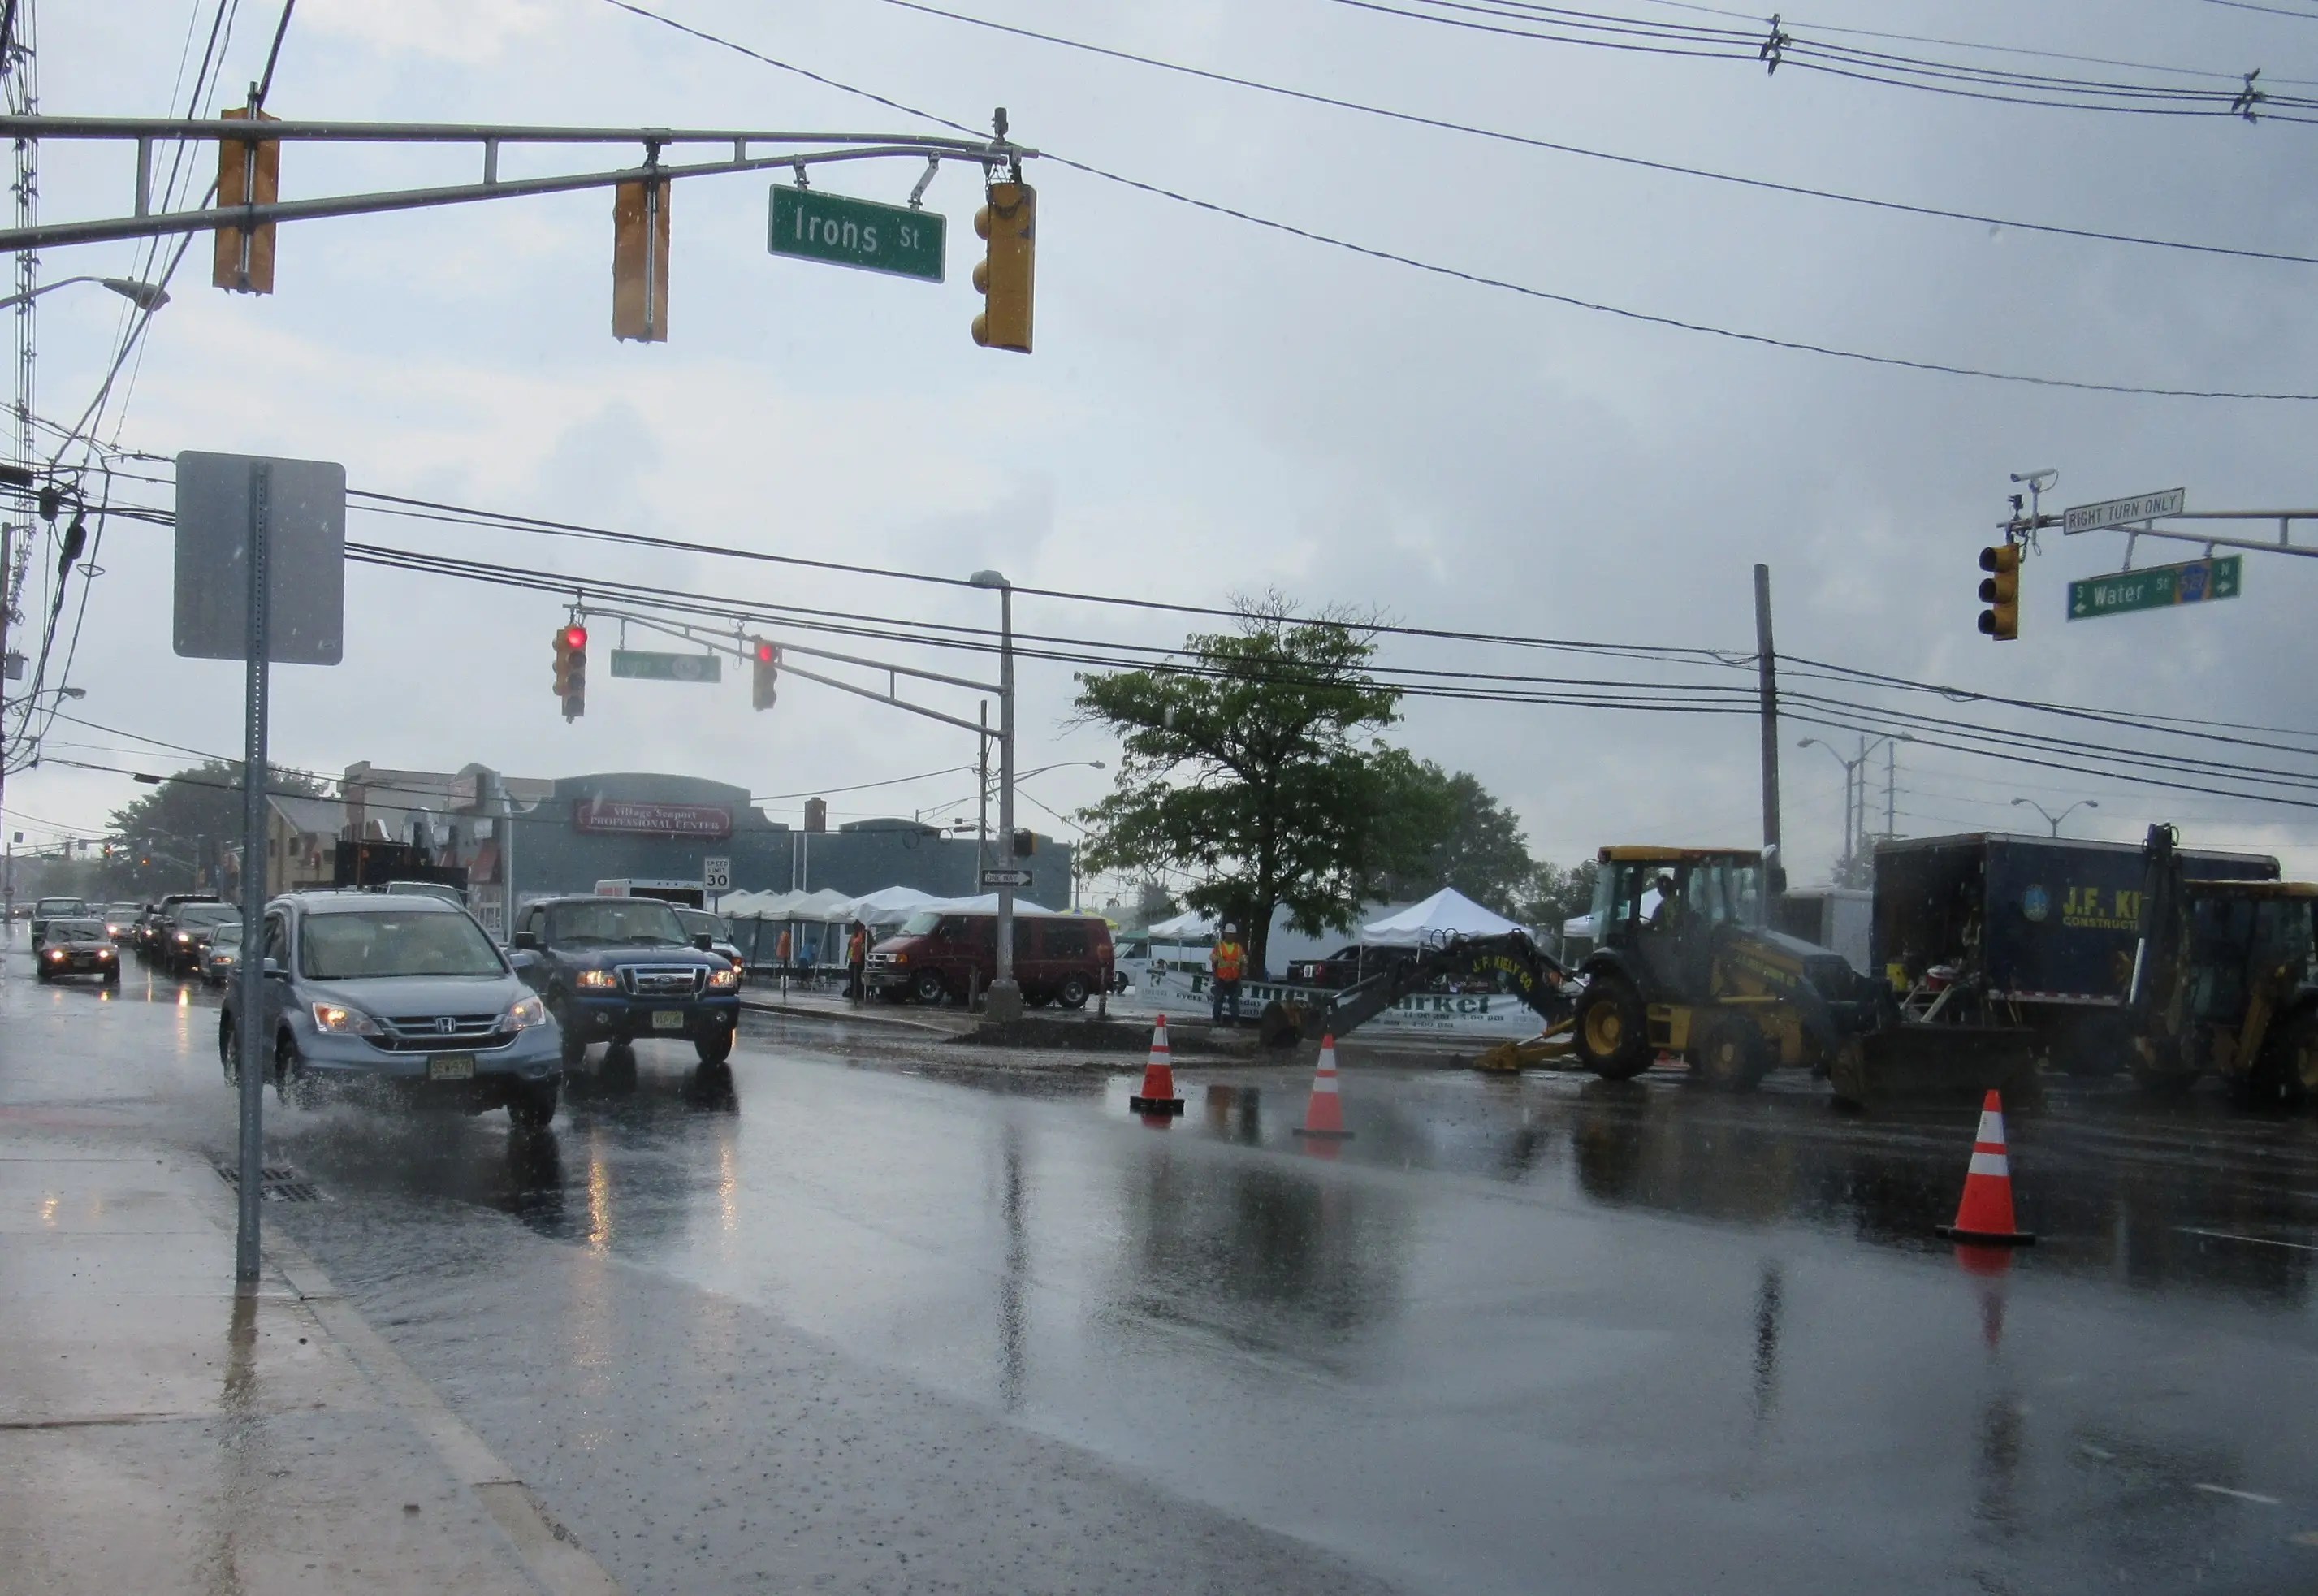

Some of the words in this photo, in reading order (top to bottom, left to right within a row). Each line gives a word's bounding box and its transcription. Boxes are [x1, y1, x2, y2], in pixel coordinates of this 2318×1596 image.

[795, 205, 878, 253] Irons
[899, 225, 920, 250] St
[2068, 508, 2103, 528] RIGHT
[2108, 502, 2140, 520] TURN
[2145, 495, 2178, 514] ONLY
[2093, 583, 2145, 607] Water
[2156, 577, 2169, 591] St
[613, 807, 651, 820] Village
[655, 808, 697, 820] Seaport
[674, 820, 720, 831] CENTER
[707, 874, 728, 886] 30
[986, 874, 1001, 882] ONE
[2062, 886, 2105, 917] J.F.
[2115, 889, 2143, 919] KI
[2062, 916, 2139, 931] CONSTRUCTI
[1176, 991, 1203, 1003] Every
[1391, 996, 1490, 1014] arket
